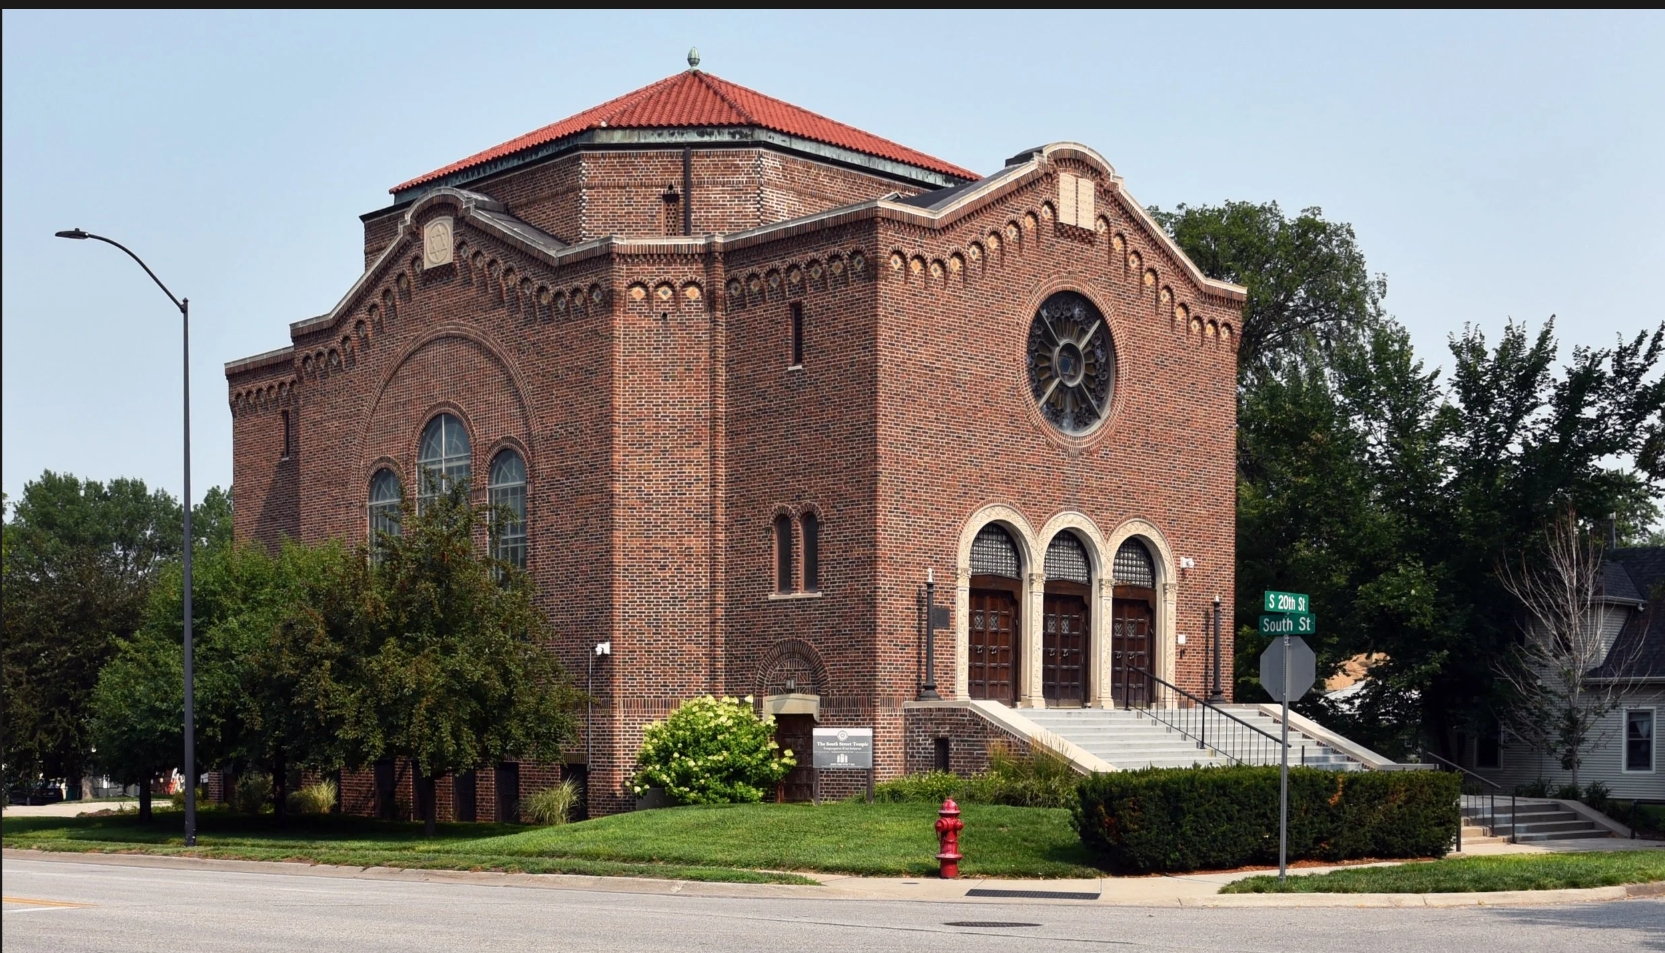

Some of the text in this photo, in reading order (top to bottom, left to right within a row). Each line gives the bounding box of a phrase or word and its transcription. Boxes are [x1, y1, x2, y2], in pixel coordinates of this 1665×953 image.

[1269, 594, 1306, 612] S 20th St
[1263, 616, 1311, 632] South St
